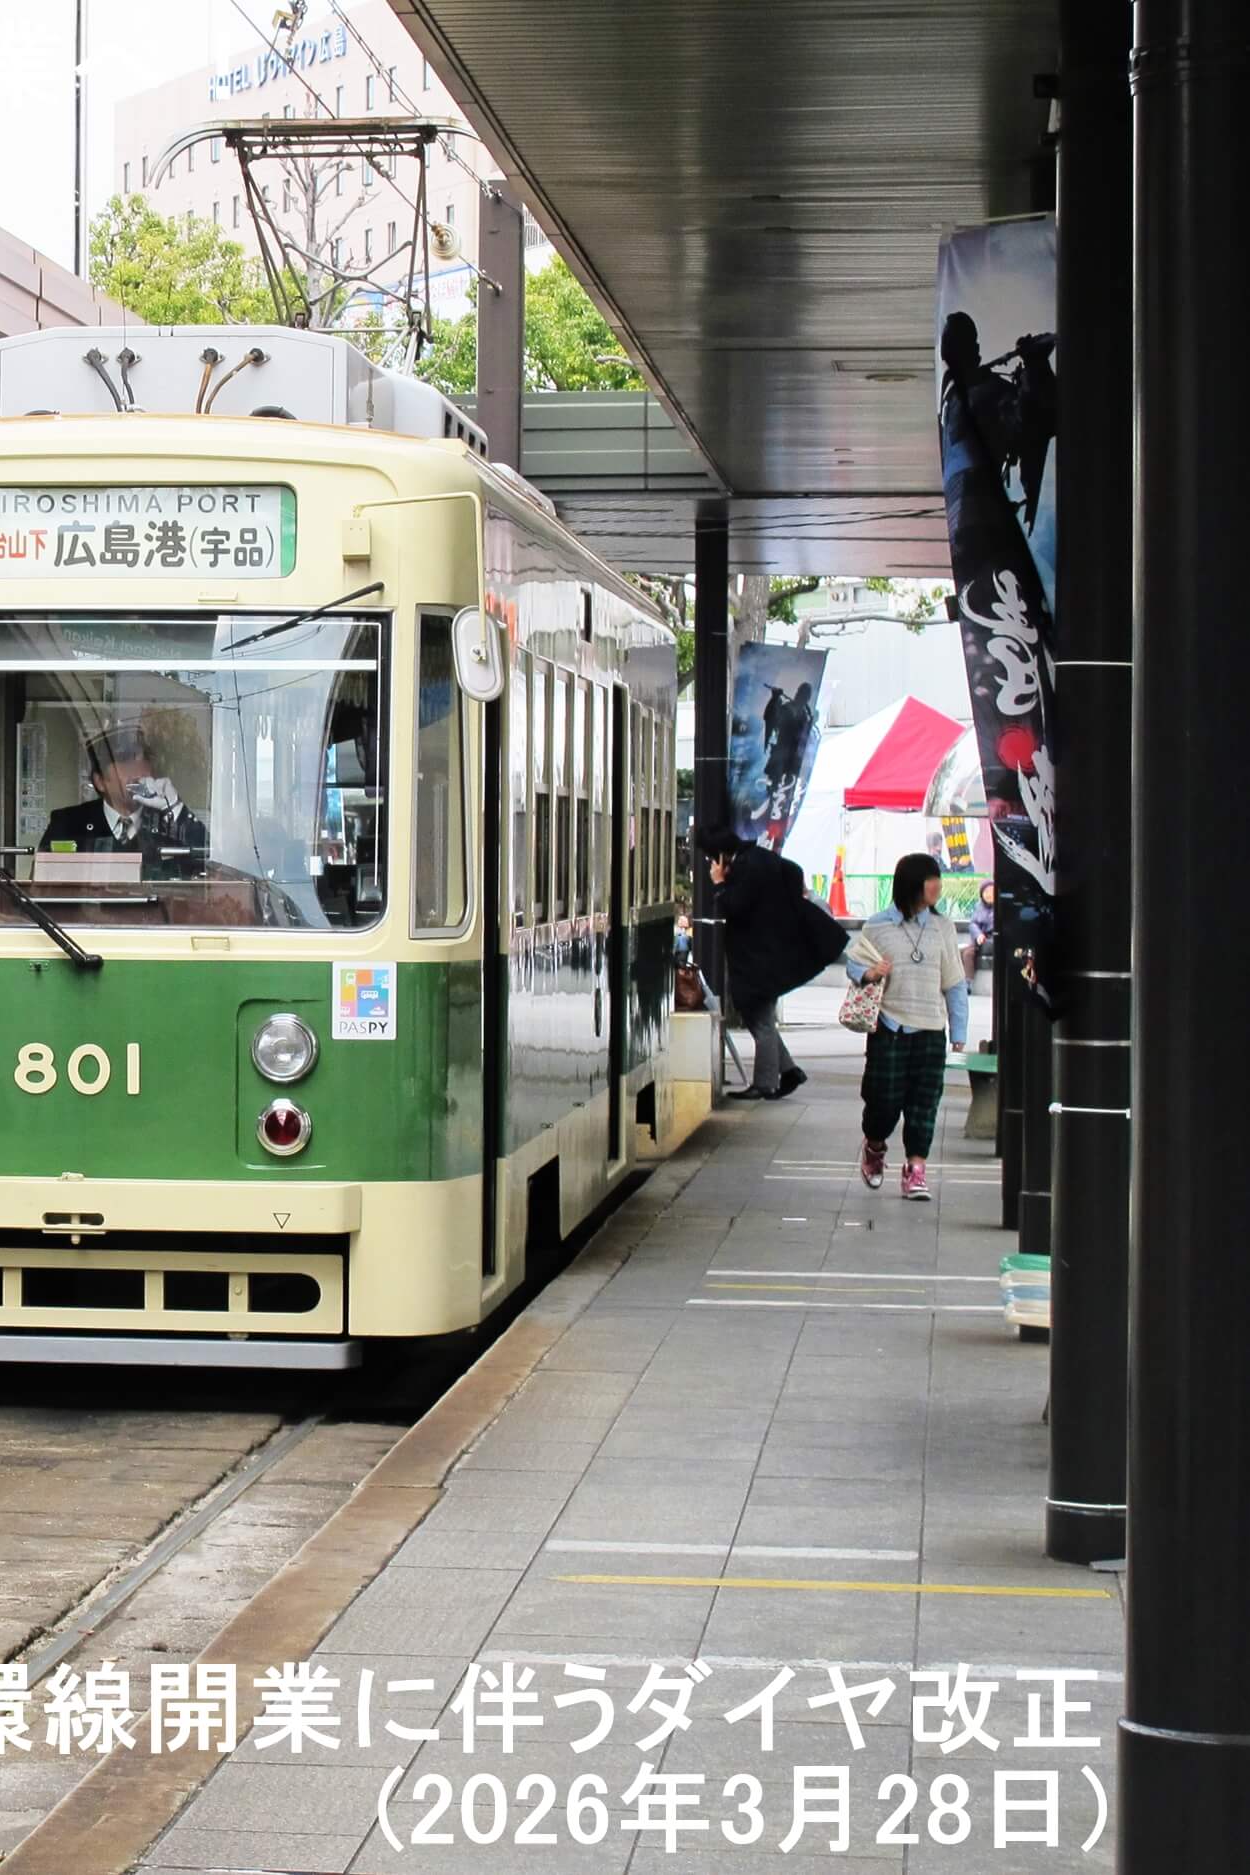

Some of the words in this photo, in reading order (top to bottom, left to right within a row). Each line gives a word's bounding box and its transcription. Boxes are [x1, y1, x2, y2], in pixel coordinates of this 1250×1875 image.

[178, 494, 261, 513] PORT
[339, 1021, 388, 1034] PASPY
[14, 1042, 140, 1095] 801
